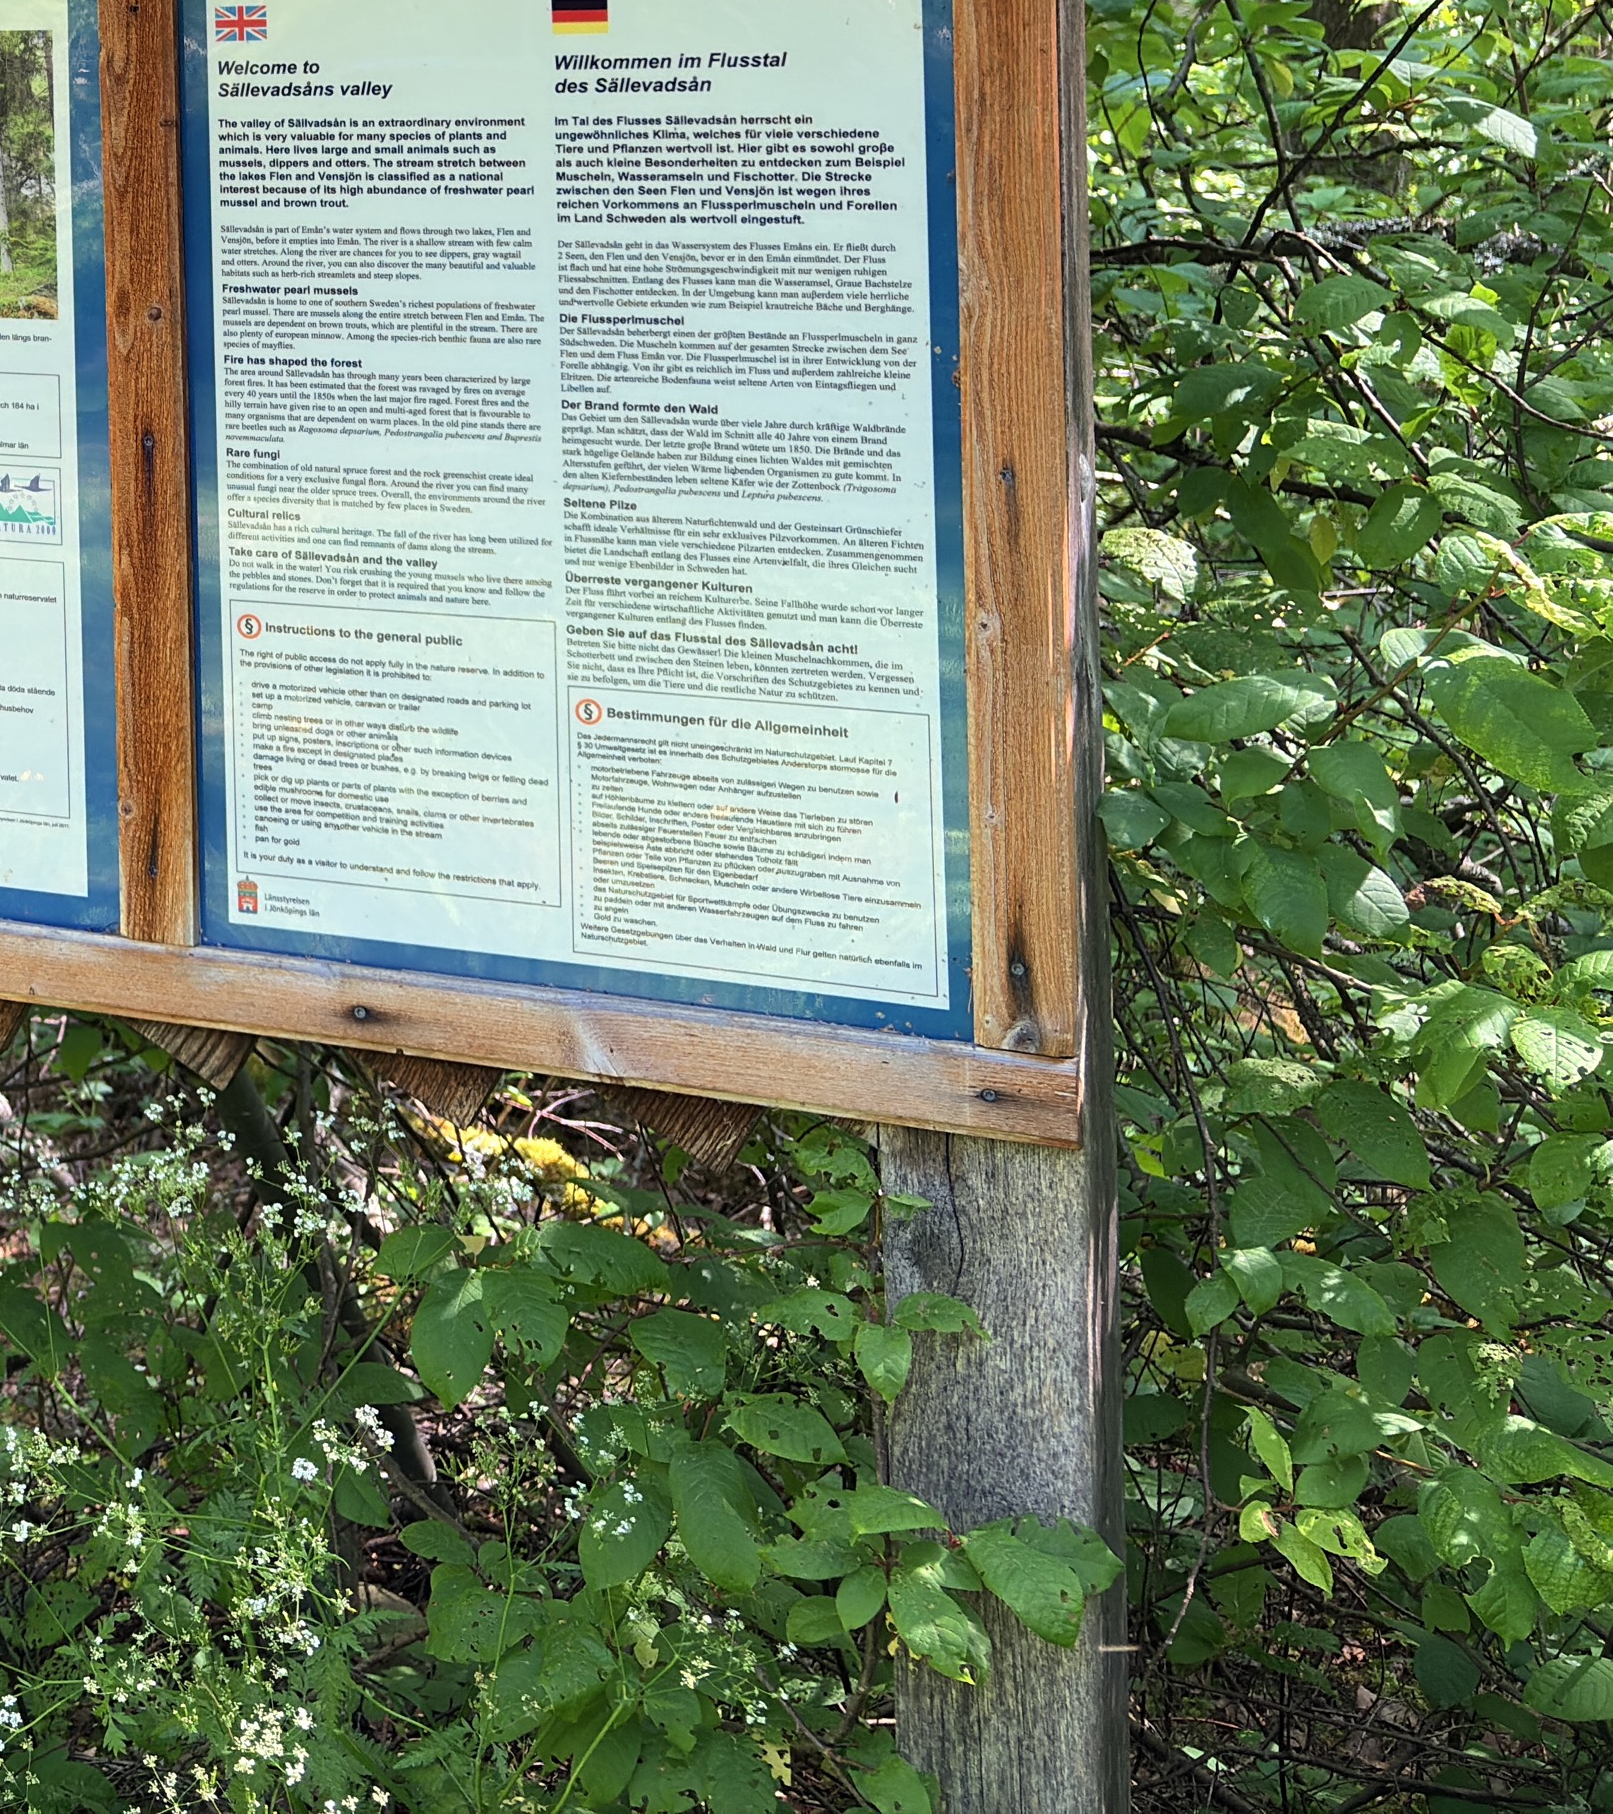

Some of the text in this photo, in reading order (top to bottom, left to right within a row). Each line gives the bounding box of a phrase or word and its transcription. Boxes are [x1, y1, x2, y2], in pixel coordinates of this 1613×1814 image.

[218, 60, 320, 75] Welcome to
[554, 51, 787, 70] Willkommen im Flusstal
[217, 80, 393, 99] Sällevadsåns valley
[554, 75, 712, 94] des Sällevadsån
[217, 118, 237, 128] The
[240, 118, 271, 130] valley
[273, 118, 285, 128] of
[349, 117, 359, 127] is
[361, 119, 375, 127] an
[378, 117, 451, 129] extraordinary
[454, 117, 525, 127] environment
[554, 114, 813, 126] Im Tal des Flusses Sällevadsån herrscht ein
[217, 130, 507, 143] which is very valuable for many species of plants and
[555, 127, 879, 142] ungewöhnliches Klima, welches für viele verschiedene
[218, 144, 496, 156] animals. Here lives large and small animals such as
[222, 283, 358, 296] Freshwater pearl mussels
[559, 313, 684, 326] Die Flussperlmuschel
[223, 354, 362, 368] Fire has shaped the forest
[561, 399, 718, 414] Der Brand formte den Wald
[226, 447, 280, 461] Rare fungi
[563, 497, 637, 510] Seltene Pilze
[265, 621, 463, 646] Instructions to the general public
[606, 707, 849, 738] Bestimmungen für die Allgemeinheit
